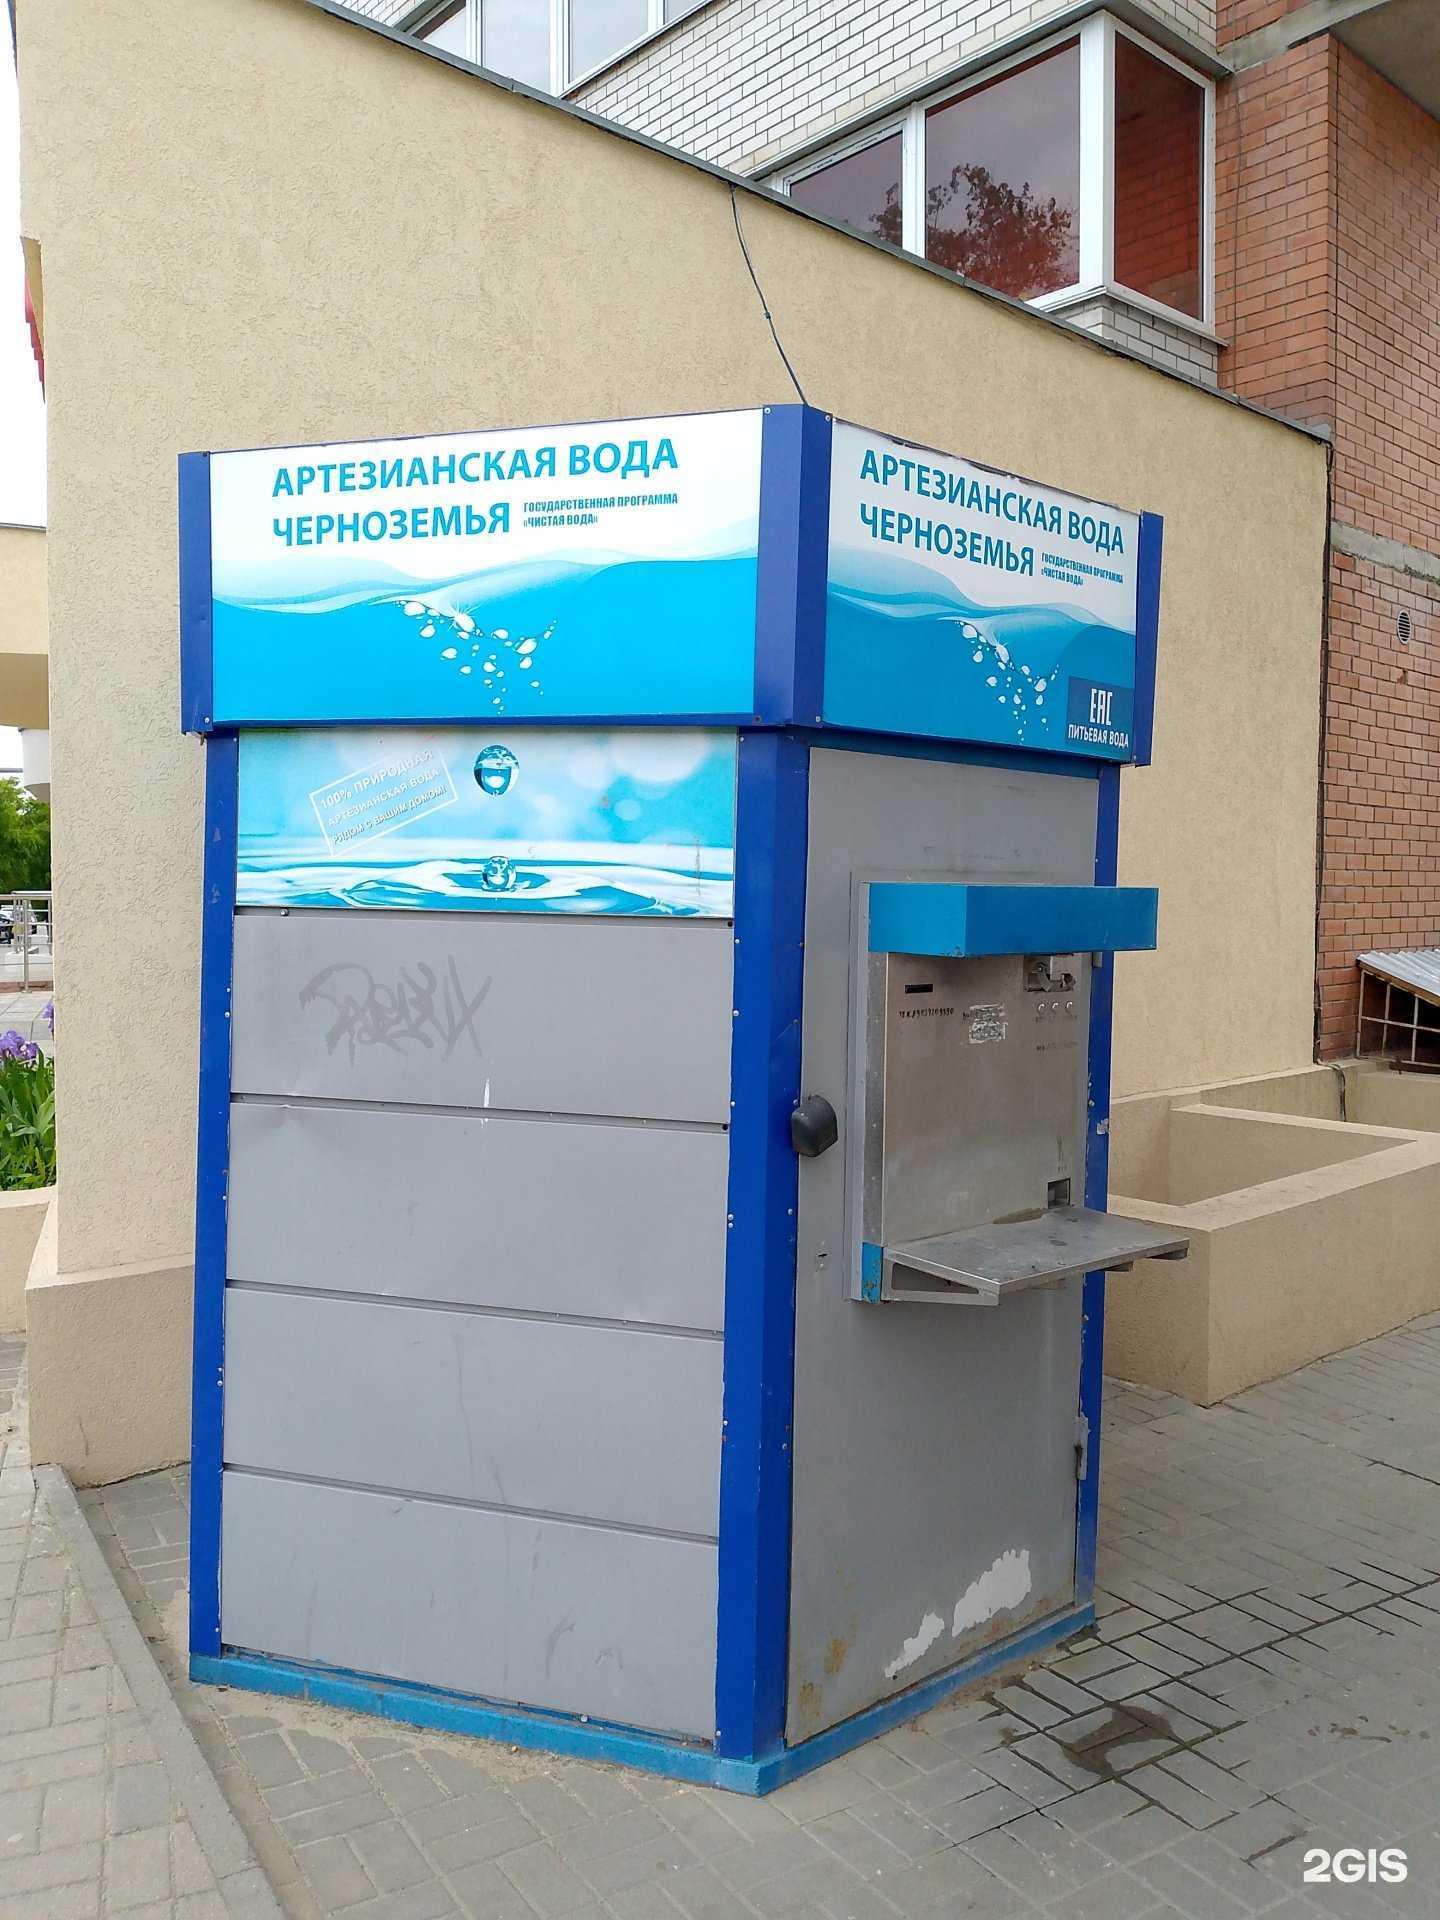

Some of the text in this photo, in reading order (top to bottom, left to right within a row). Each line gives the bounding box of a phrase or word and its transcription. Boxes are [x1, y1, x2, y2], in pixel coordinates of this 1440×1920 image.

[272, 438, 678, 497] АРТЕЗИАНСКАЯ ВОДА
[273, 502, 510, 546] ЧЕРНОЗЕМЬЯ
[523, 493, 678, 513] ГОСУДАРСТВЕННАЯ ПРОГРАММА
[860, 449, 1125, 556] АРТЕЗИАНСКАЯ ВОДА
[860, 502, 1034, 577] ЧЕРНОЗЕМЬЯ
[1041, 552, 1093, 575] ГОСУДАРСТВЕННАЯ
[1068, 724, 1129, 749] ПИТЬЕВАЯ ВОДА
[320, 749, 434, 809] 100% ПРИРОДНАЯ
[328, 782, 408, 827] АРТЕЗИАНСКАЯ
[374, 802, 410, 826] ВАШИМ
